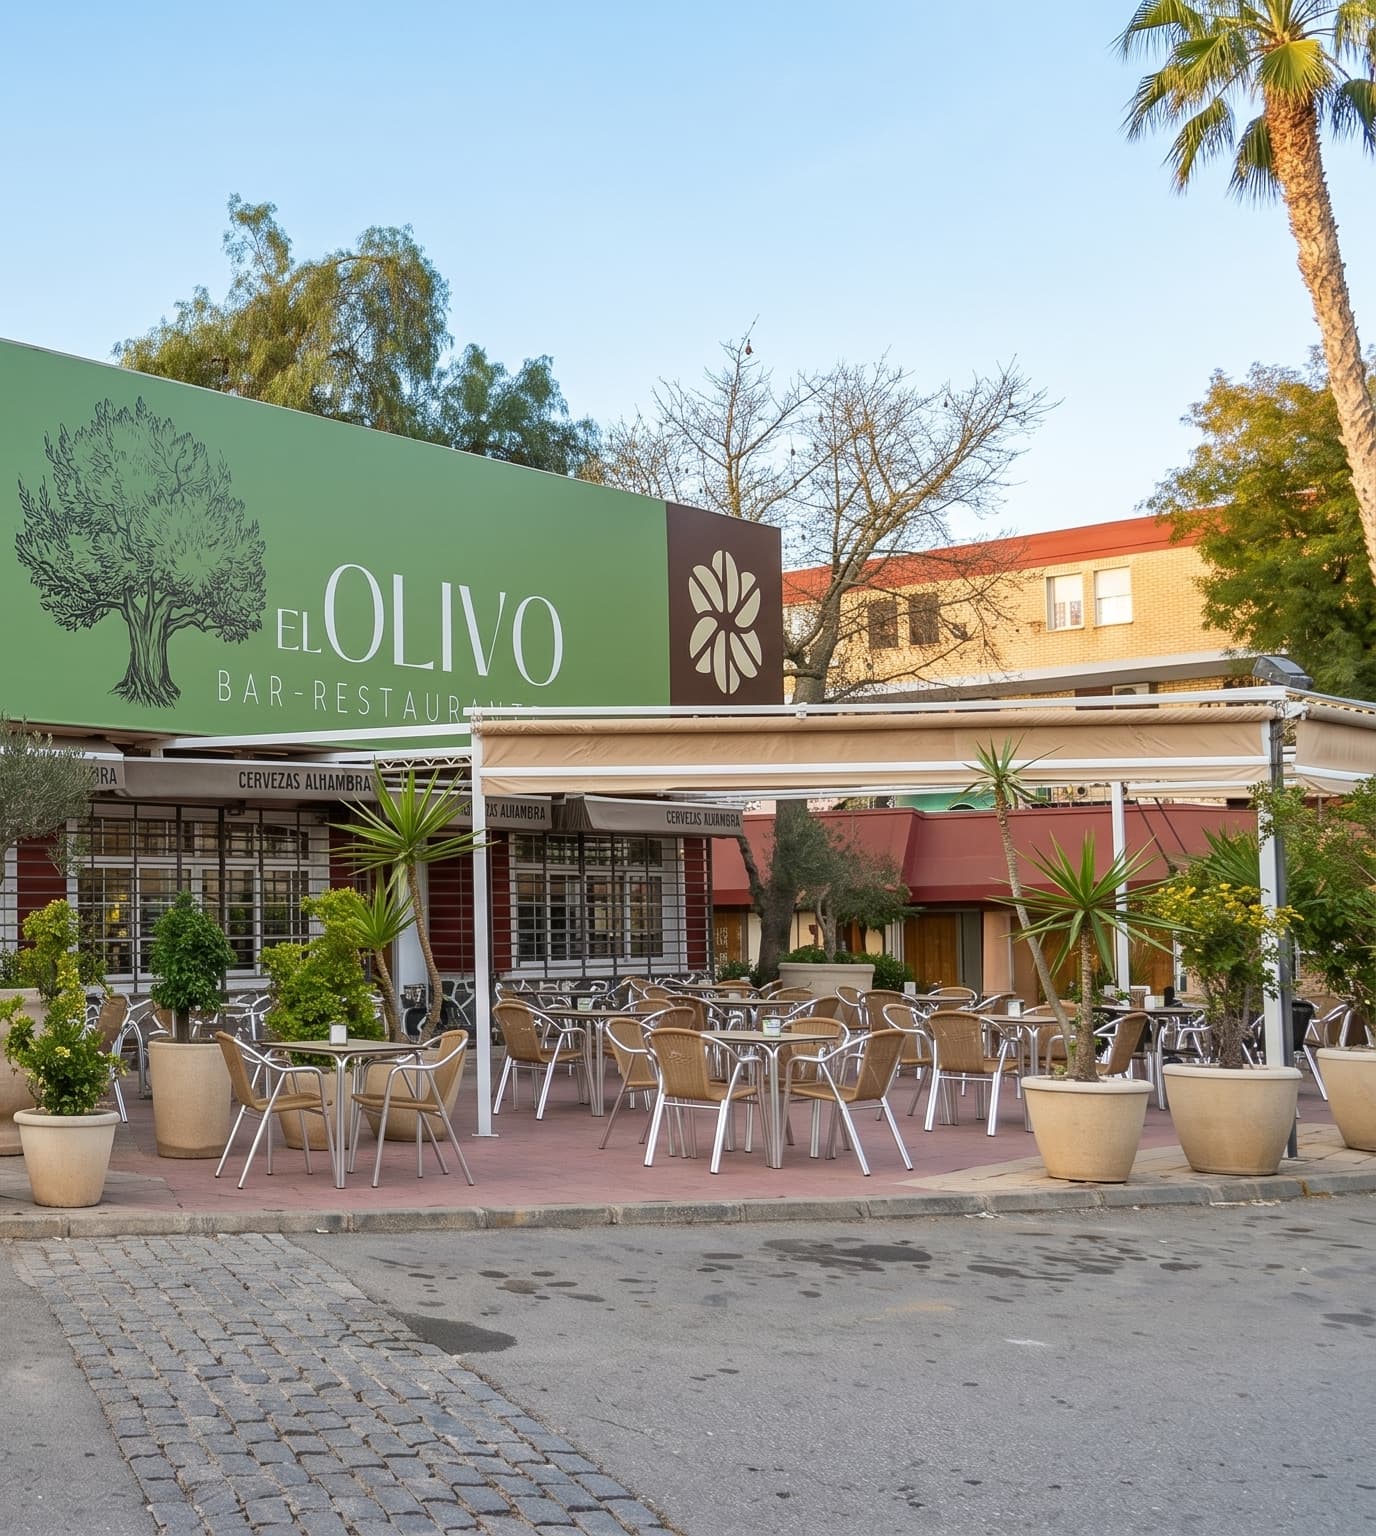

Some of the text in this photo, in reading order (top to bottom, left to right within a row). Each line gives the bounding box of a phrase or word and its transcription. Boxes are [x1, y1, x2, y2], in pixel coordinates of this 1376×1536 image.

[276, 563, 564, 687] EL OLIVO
[238, 771, 372, 792] CERVEZAS ALHAMBRA
